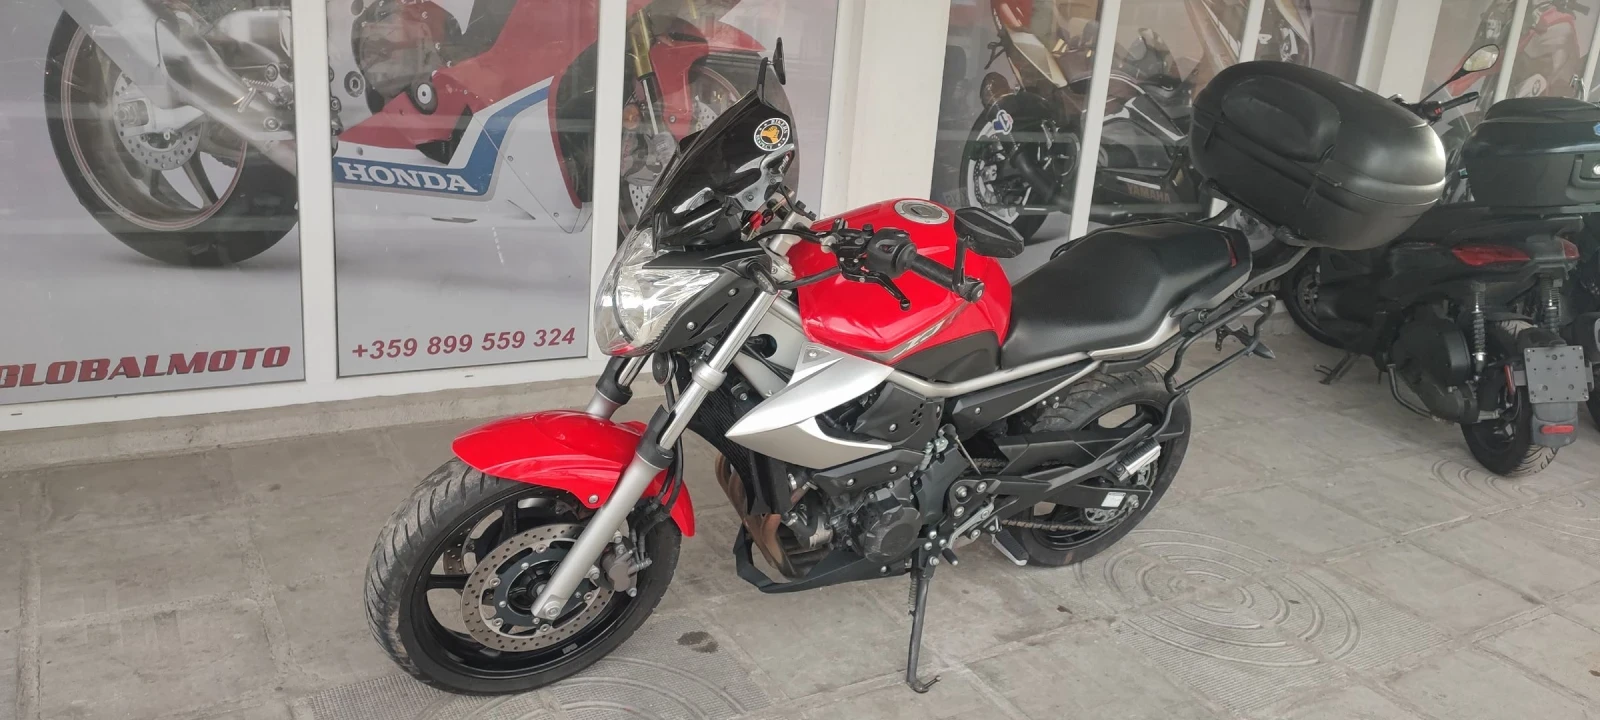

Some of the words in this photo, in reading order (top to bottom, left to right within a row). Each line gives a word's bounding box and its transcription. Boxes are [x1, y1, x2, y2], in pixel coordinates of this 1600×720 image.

[338, 162, 478, 193] HONDA
[1126, 183, 1171, 204] YAMAHA
[352, 338, 418, 360] +359
[426, 334, 473, 355] 899
[481, 330, 526, 351] 559
[533, 327, 576, 347] 324
[0, 346, 291, 388] GLOBALMOTO
